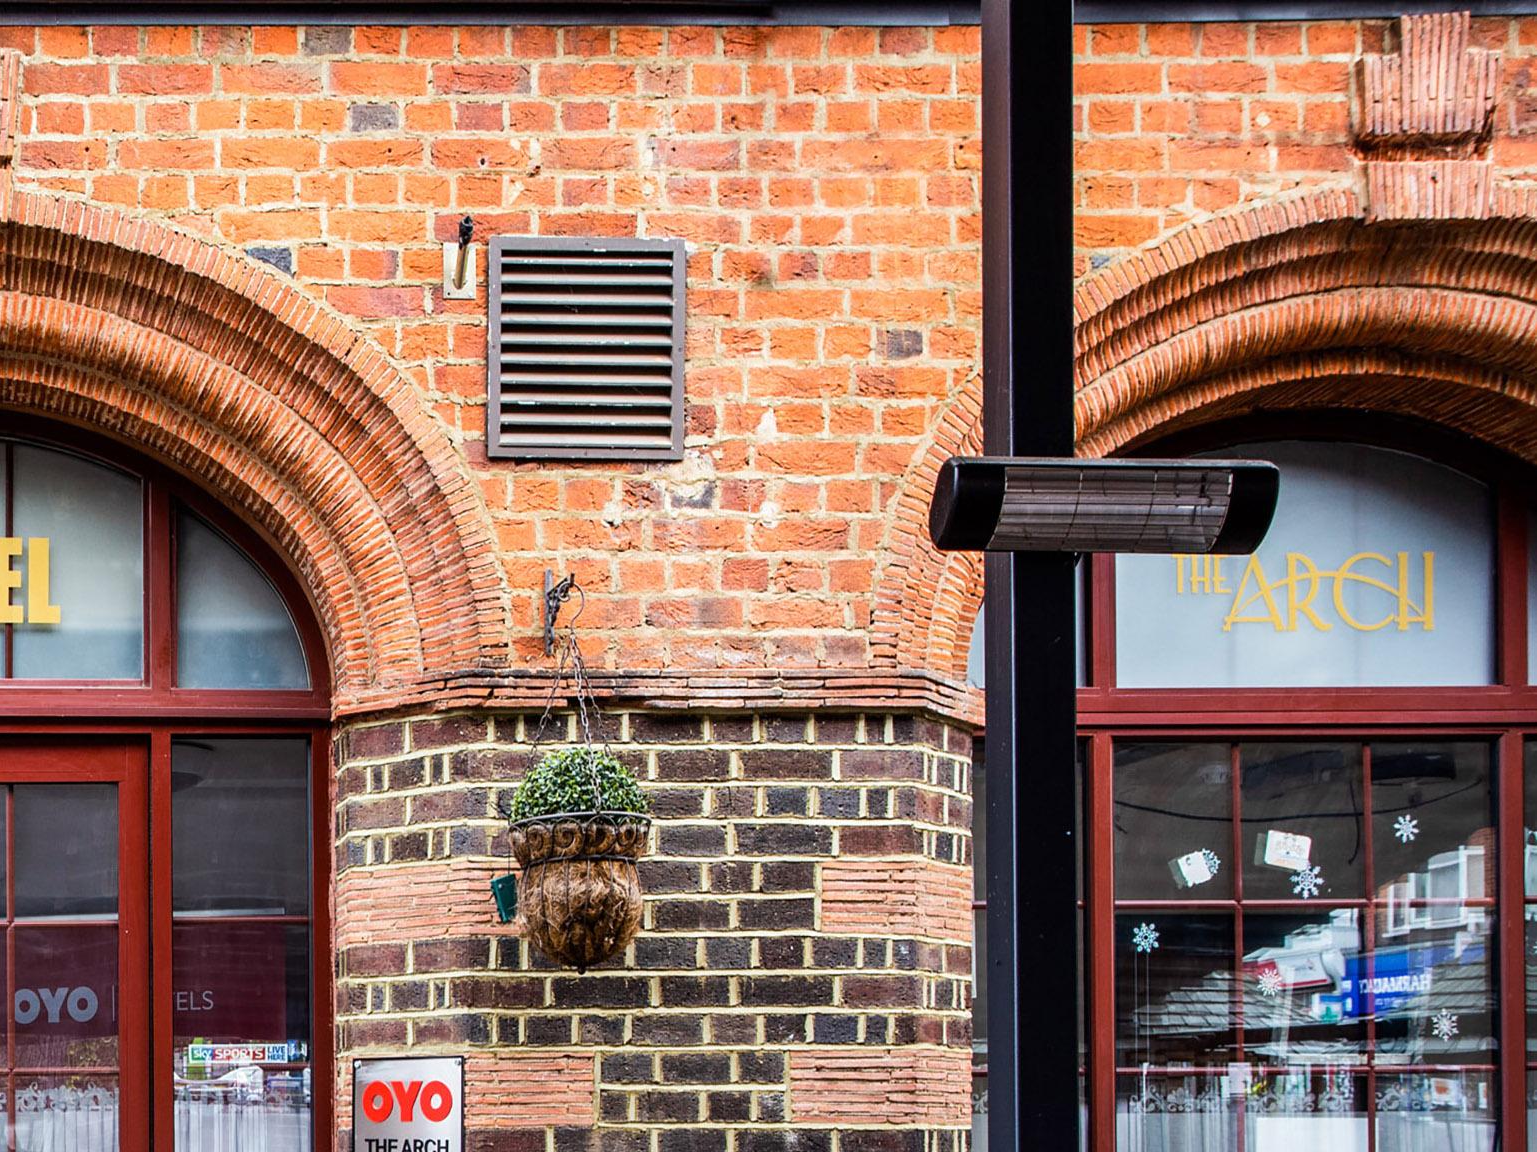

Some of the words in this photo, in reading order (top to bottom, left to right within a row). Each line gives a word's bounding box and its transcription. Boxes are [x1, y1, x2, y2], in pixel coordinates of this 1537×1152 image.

[1171, 553, 1233, 595] THE
[1221, 551, 1436, 632] ARCH
[14, 985, 99, 1025] OYO
[173, 990, 215, 1012] ELS
[193, 1047, 212, 1061] sky
[214, 1048, 264, 1060] SPORTS
[267, 1053, 286, 1061] HERE
[362, 1080, 453, 1123] OYO
